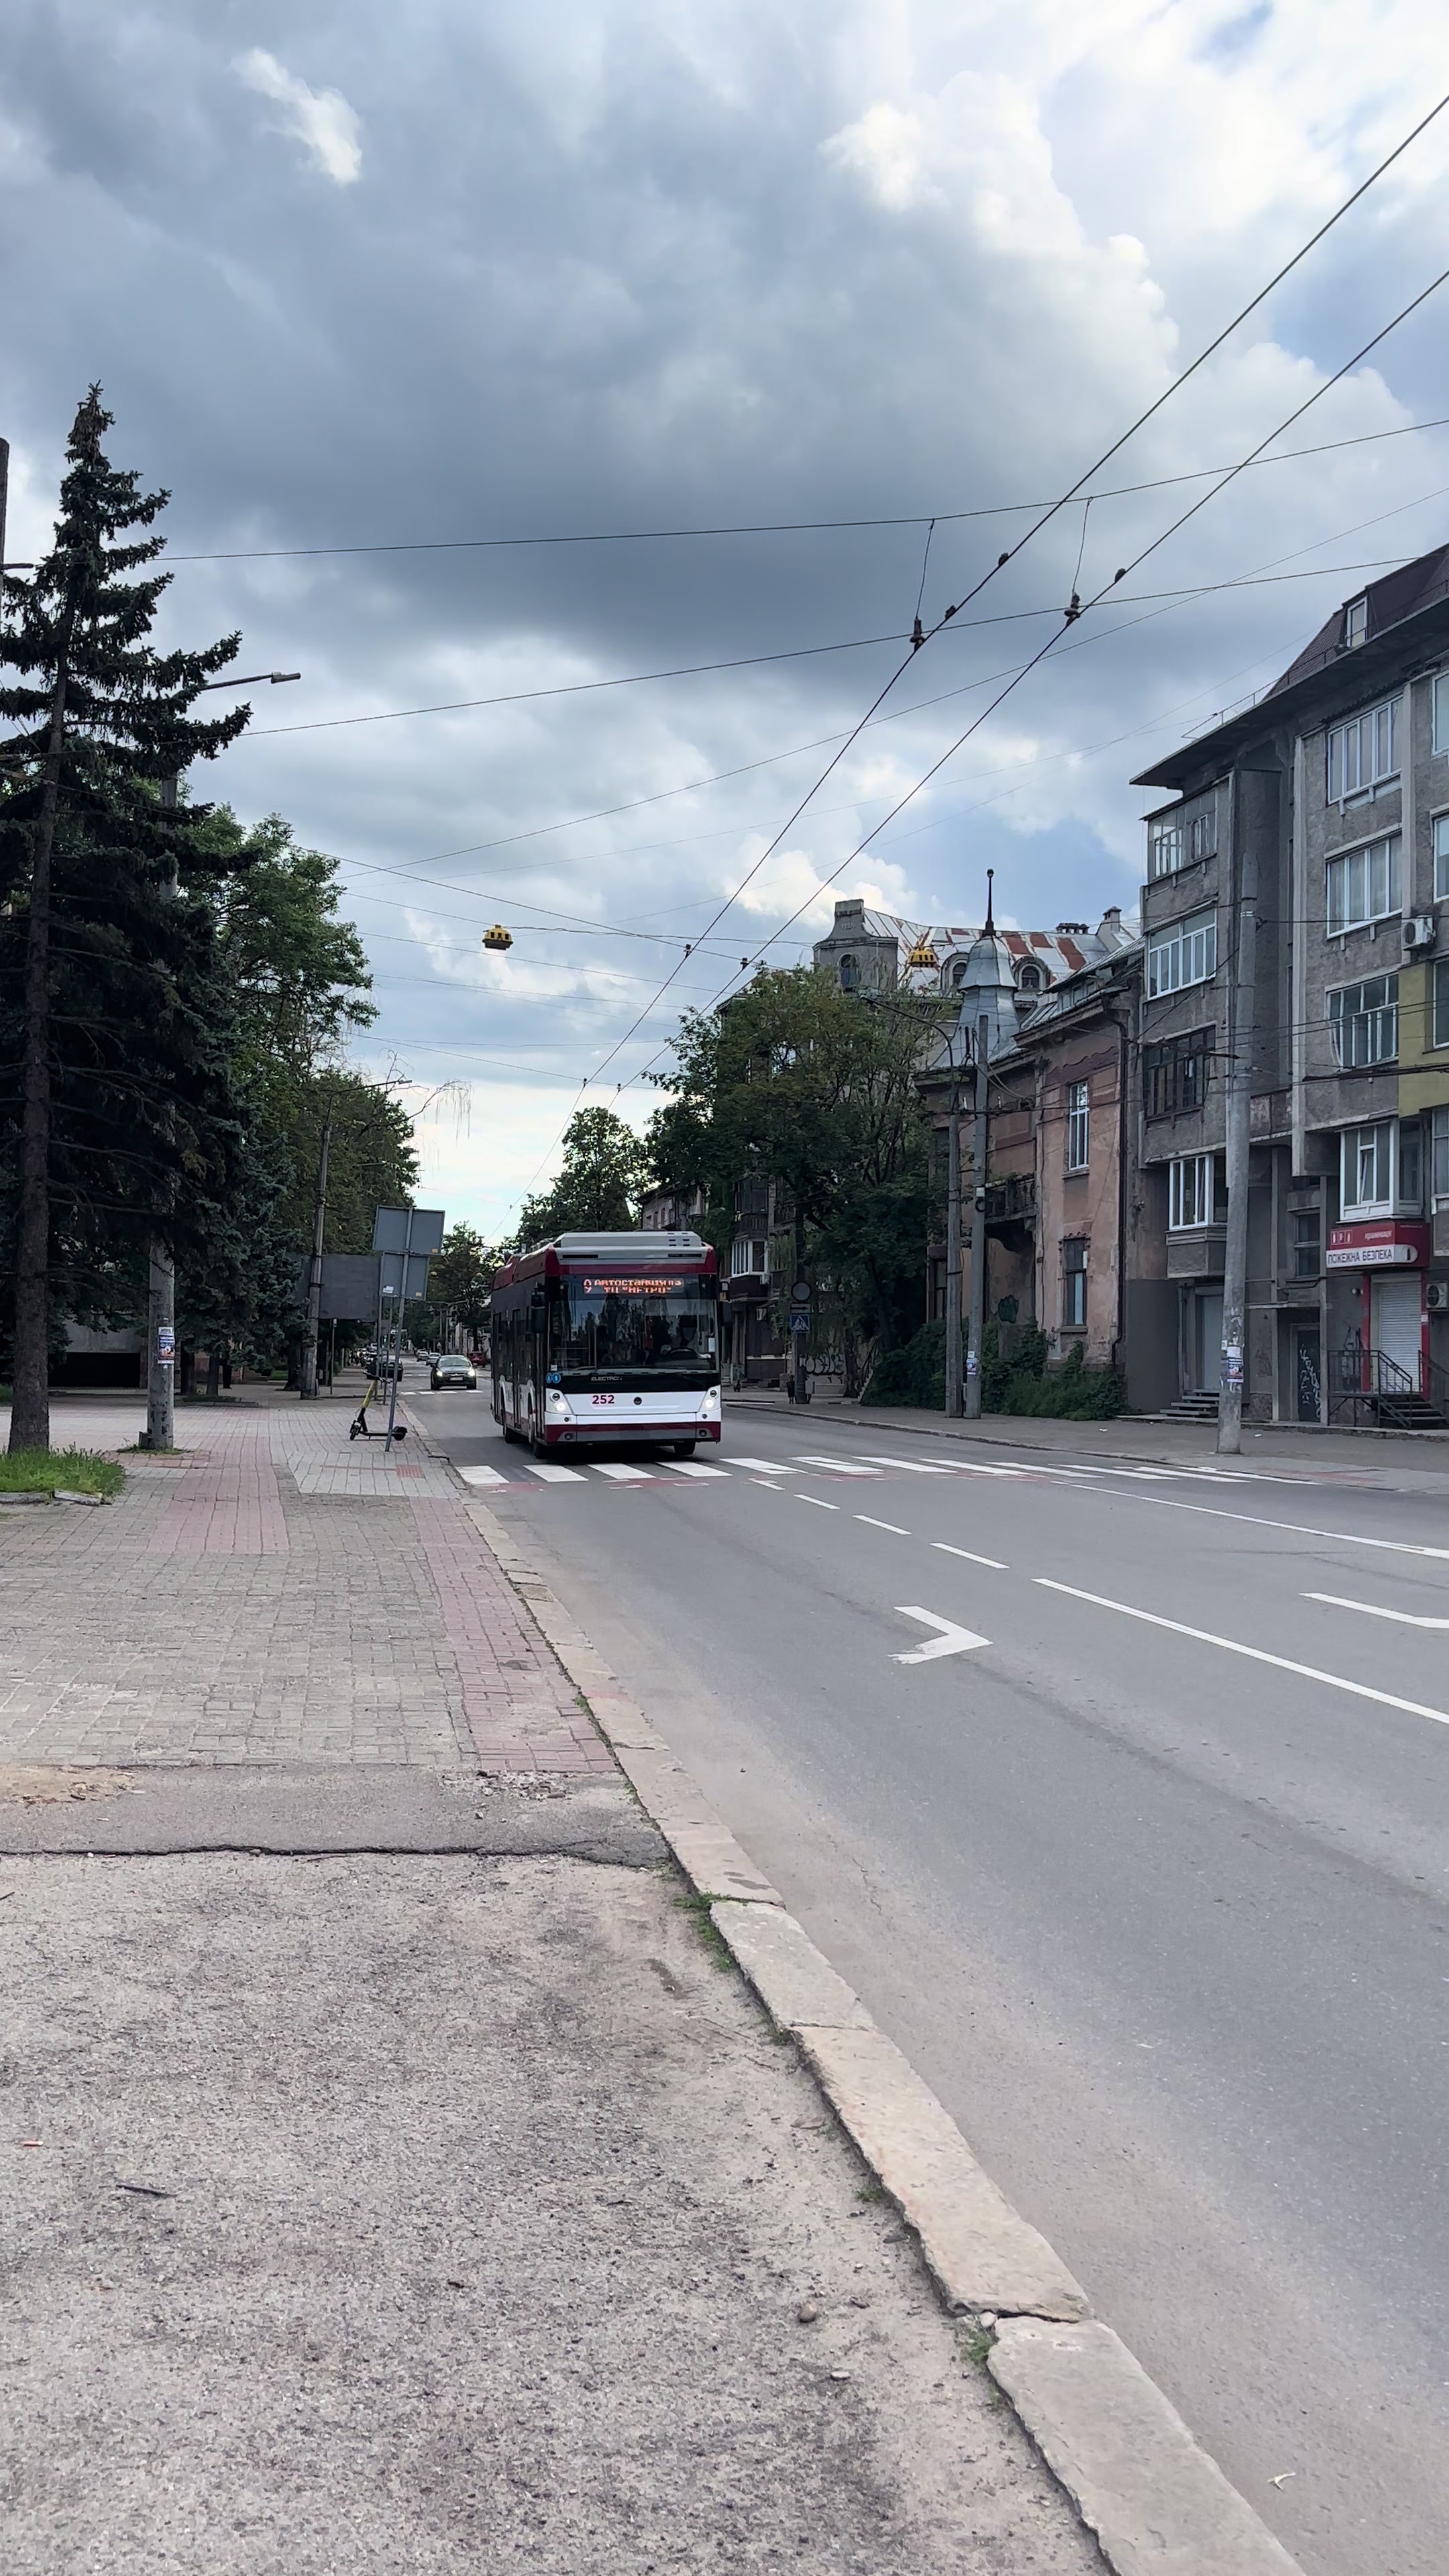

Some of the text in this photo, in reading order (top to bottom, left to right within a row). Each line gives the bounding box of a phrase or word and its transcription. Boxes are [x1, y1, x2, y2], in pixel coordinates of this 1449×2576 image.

[1328, 1248, 1392, 1264] ПОЖЕЖНА БЕЗПЕКА
[592, 1395, 614, 1404] 252
